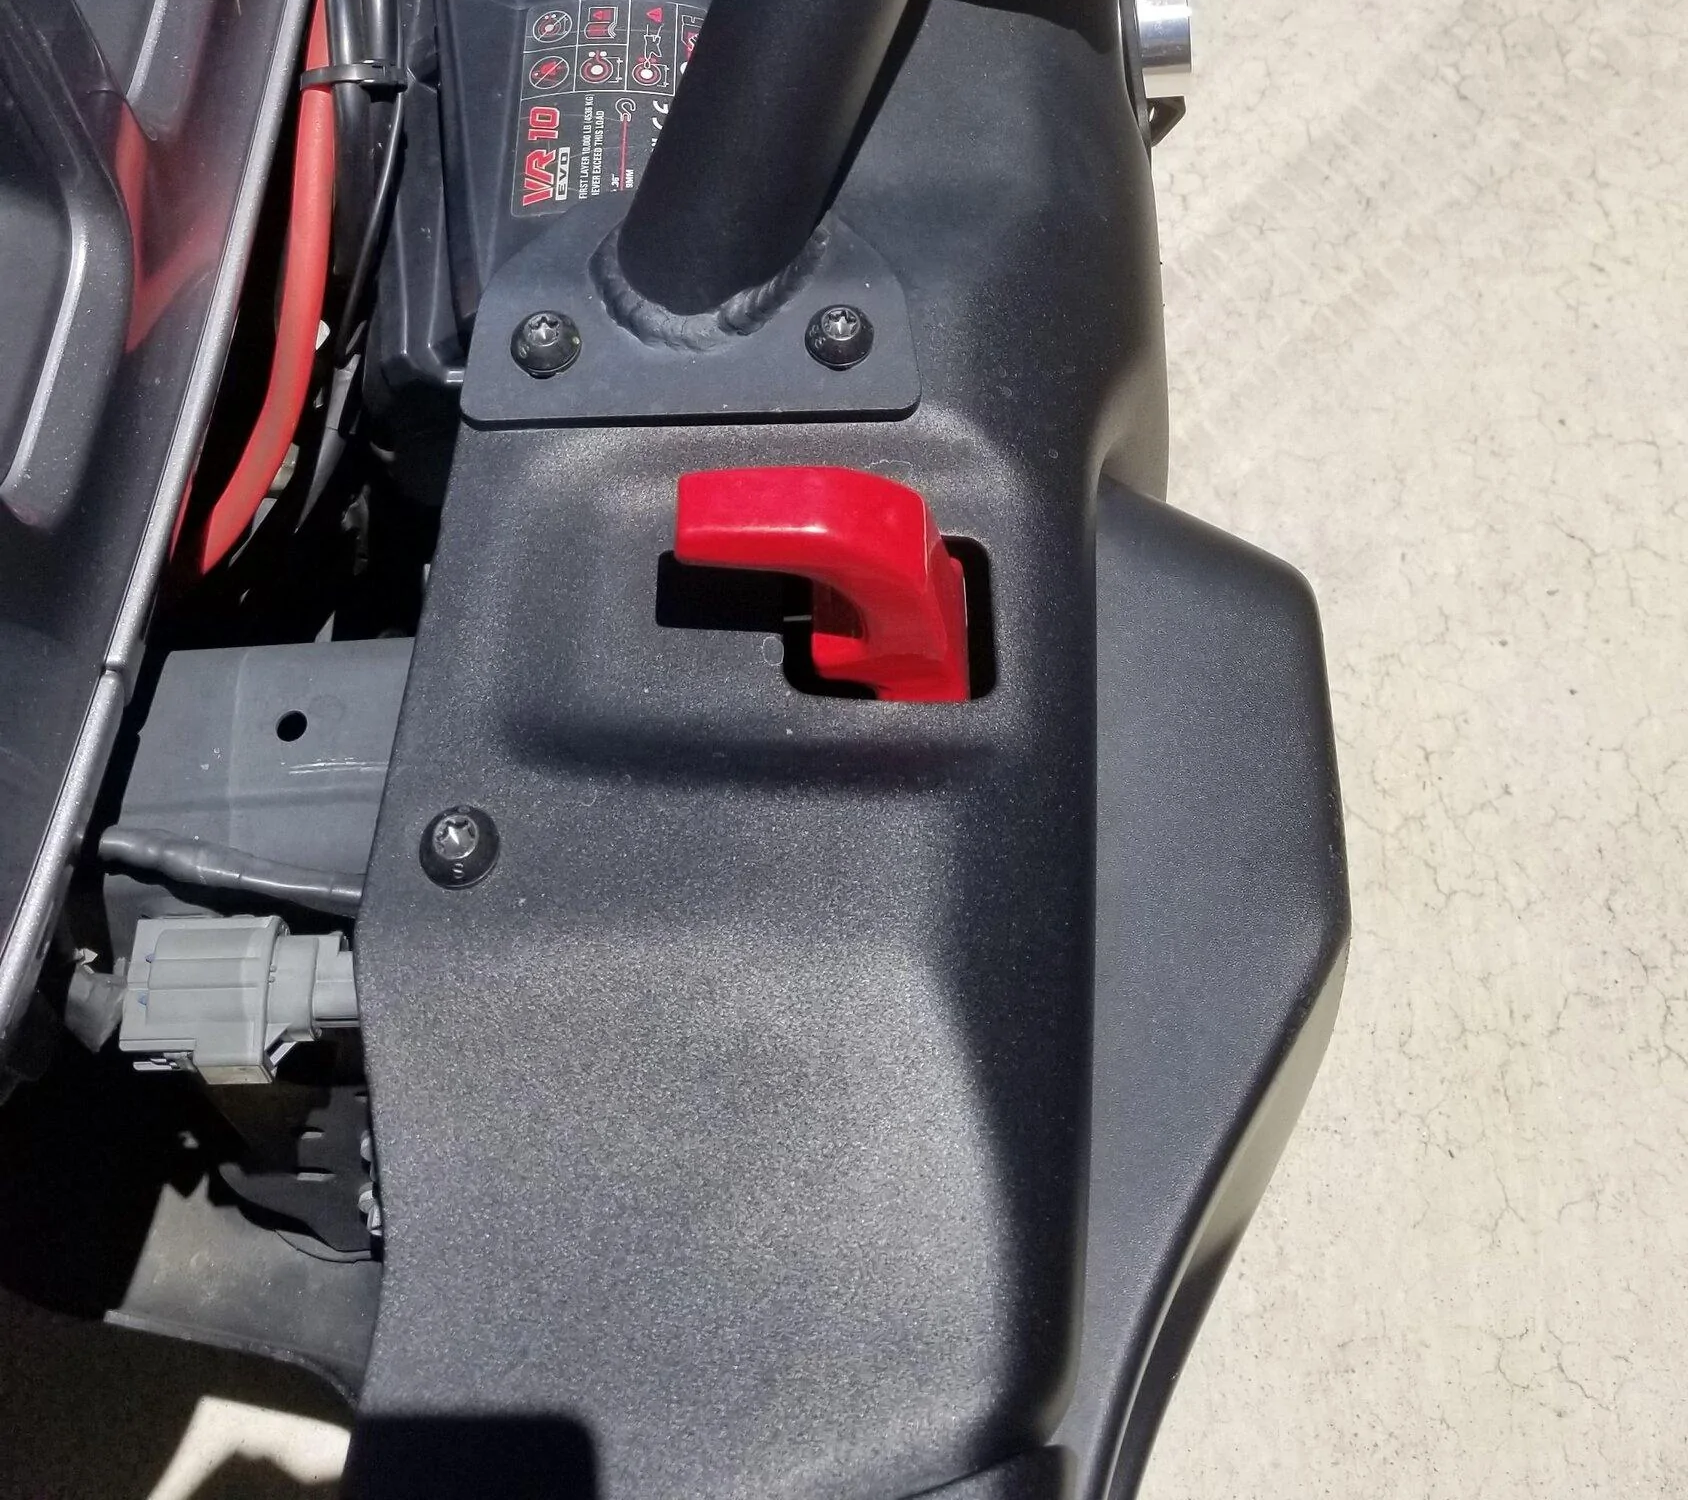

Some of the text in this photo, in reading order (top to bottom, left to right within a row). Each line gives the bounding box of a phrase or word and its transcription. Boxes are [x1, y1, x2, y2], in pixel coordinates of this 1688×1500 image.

[584, 124, 592, 134] LB
[596, 110, 605, 129] LOAD
[594, 130, 604, 147] THIS
[522, 106, 560, 206] VR 10
[592, 148, 603, 174] EXCEED
[557, 151, 569, 197] EVO
[580, 156, 590, 178] LAYER
[578, 179, 588, 199] FIRST
